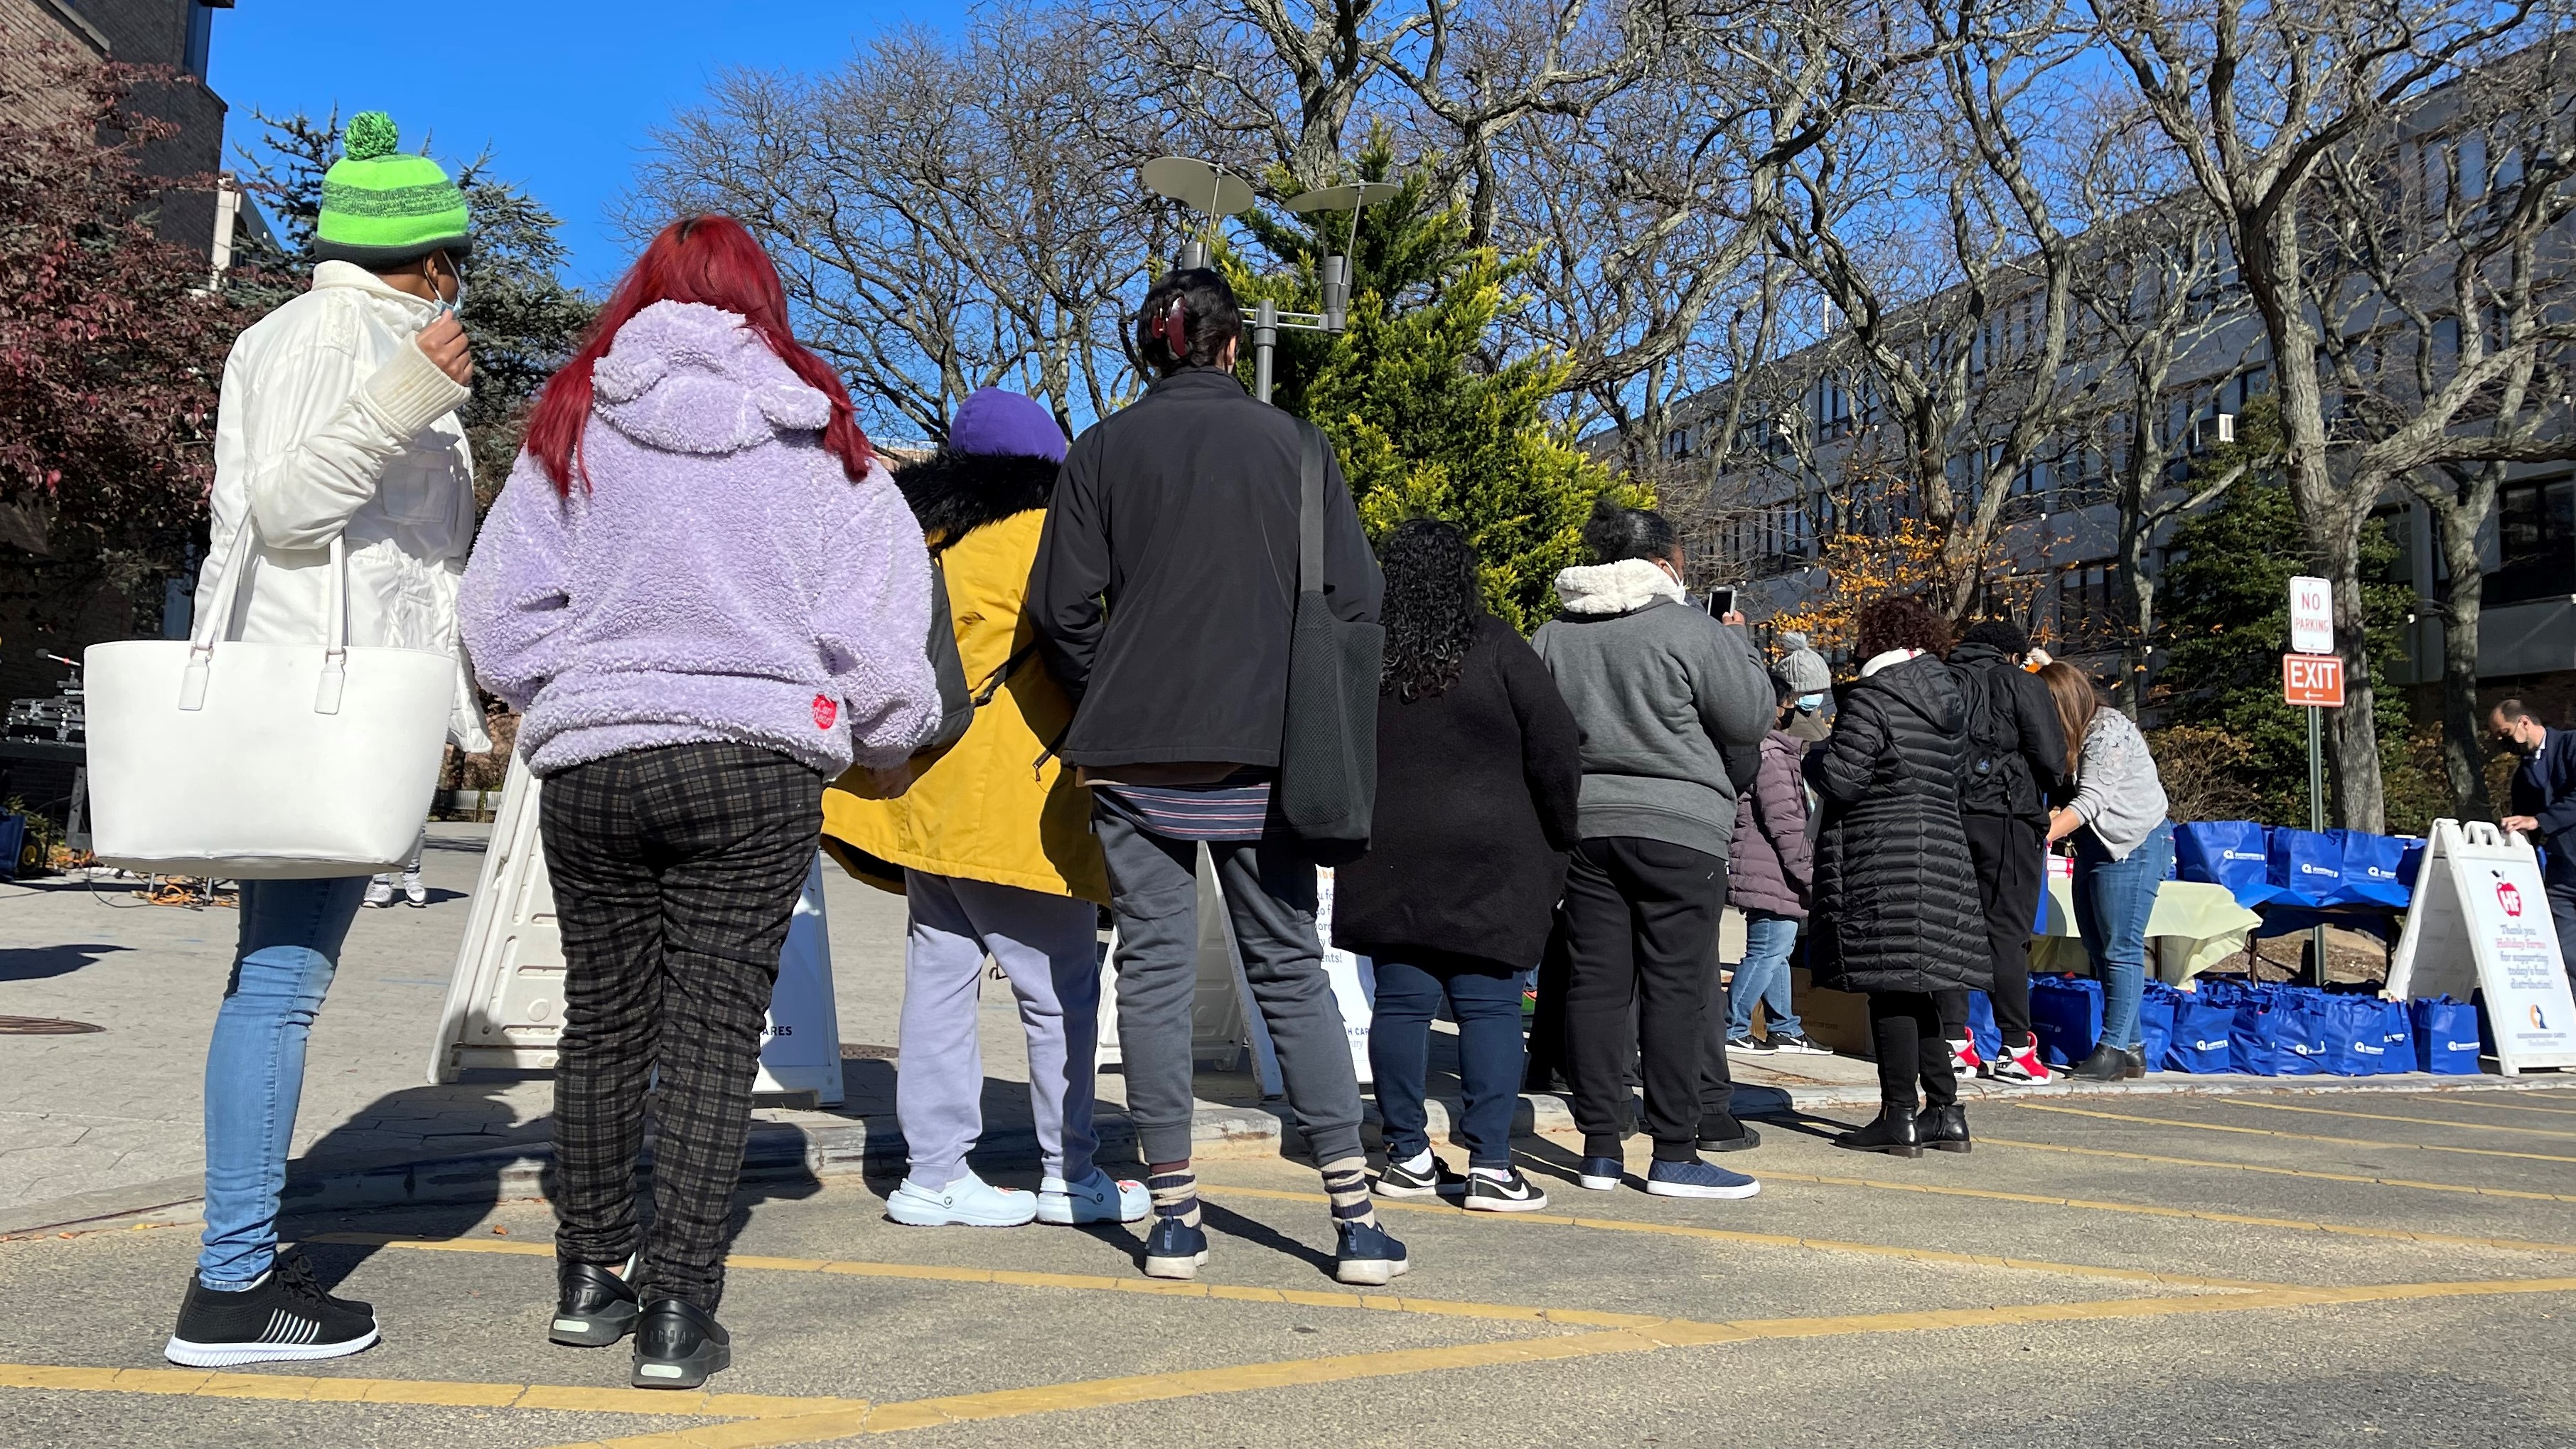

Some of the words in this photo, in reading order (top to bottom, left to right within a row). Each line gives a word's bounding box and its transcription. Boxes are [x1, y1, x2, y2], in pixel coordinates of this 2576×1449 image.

[2302, 592, 2320, 610] NO
[2296, 617, 2329, 633] PARKING
[2290, 661, 2336, 690] EXIT
[2499, 890, 2520, 912] HF
[762, 1026, 793, 1036] ARES
